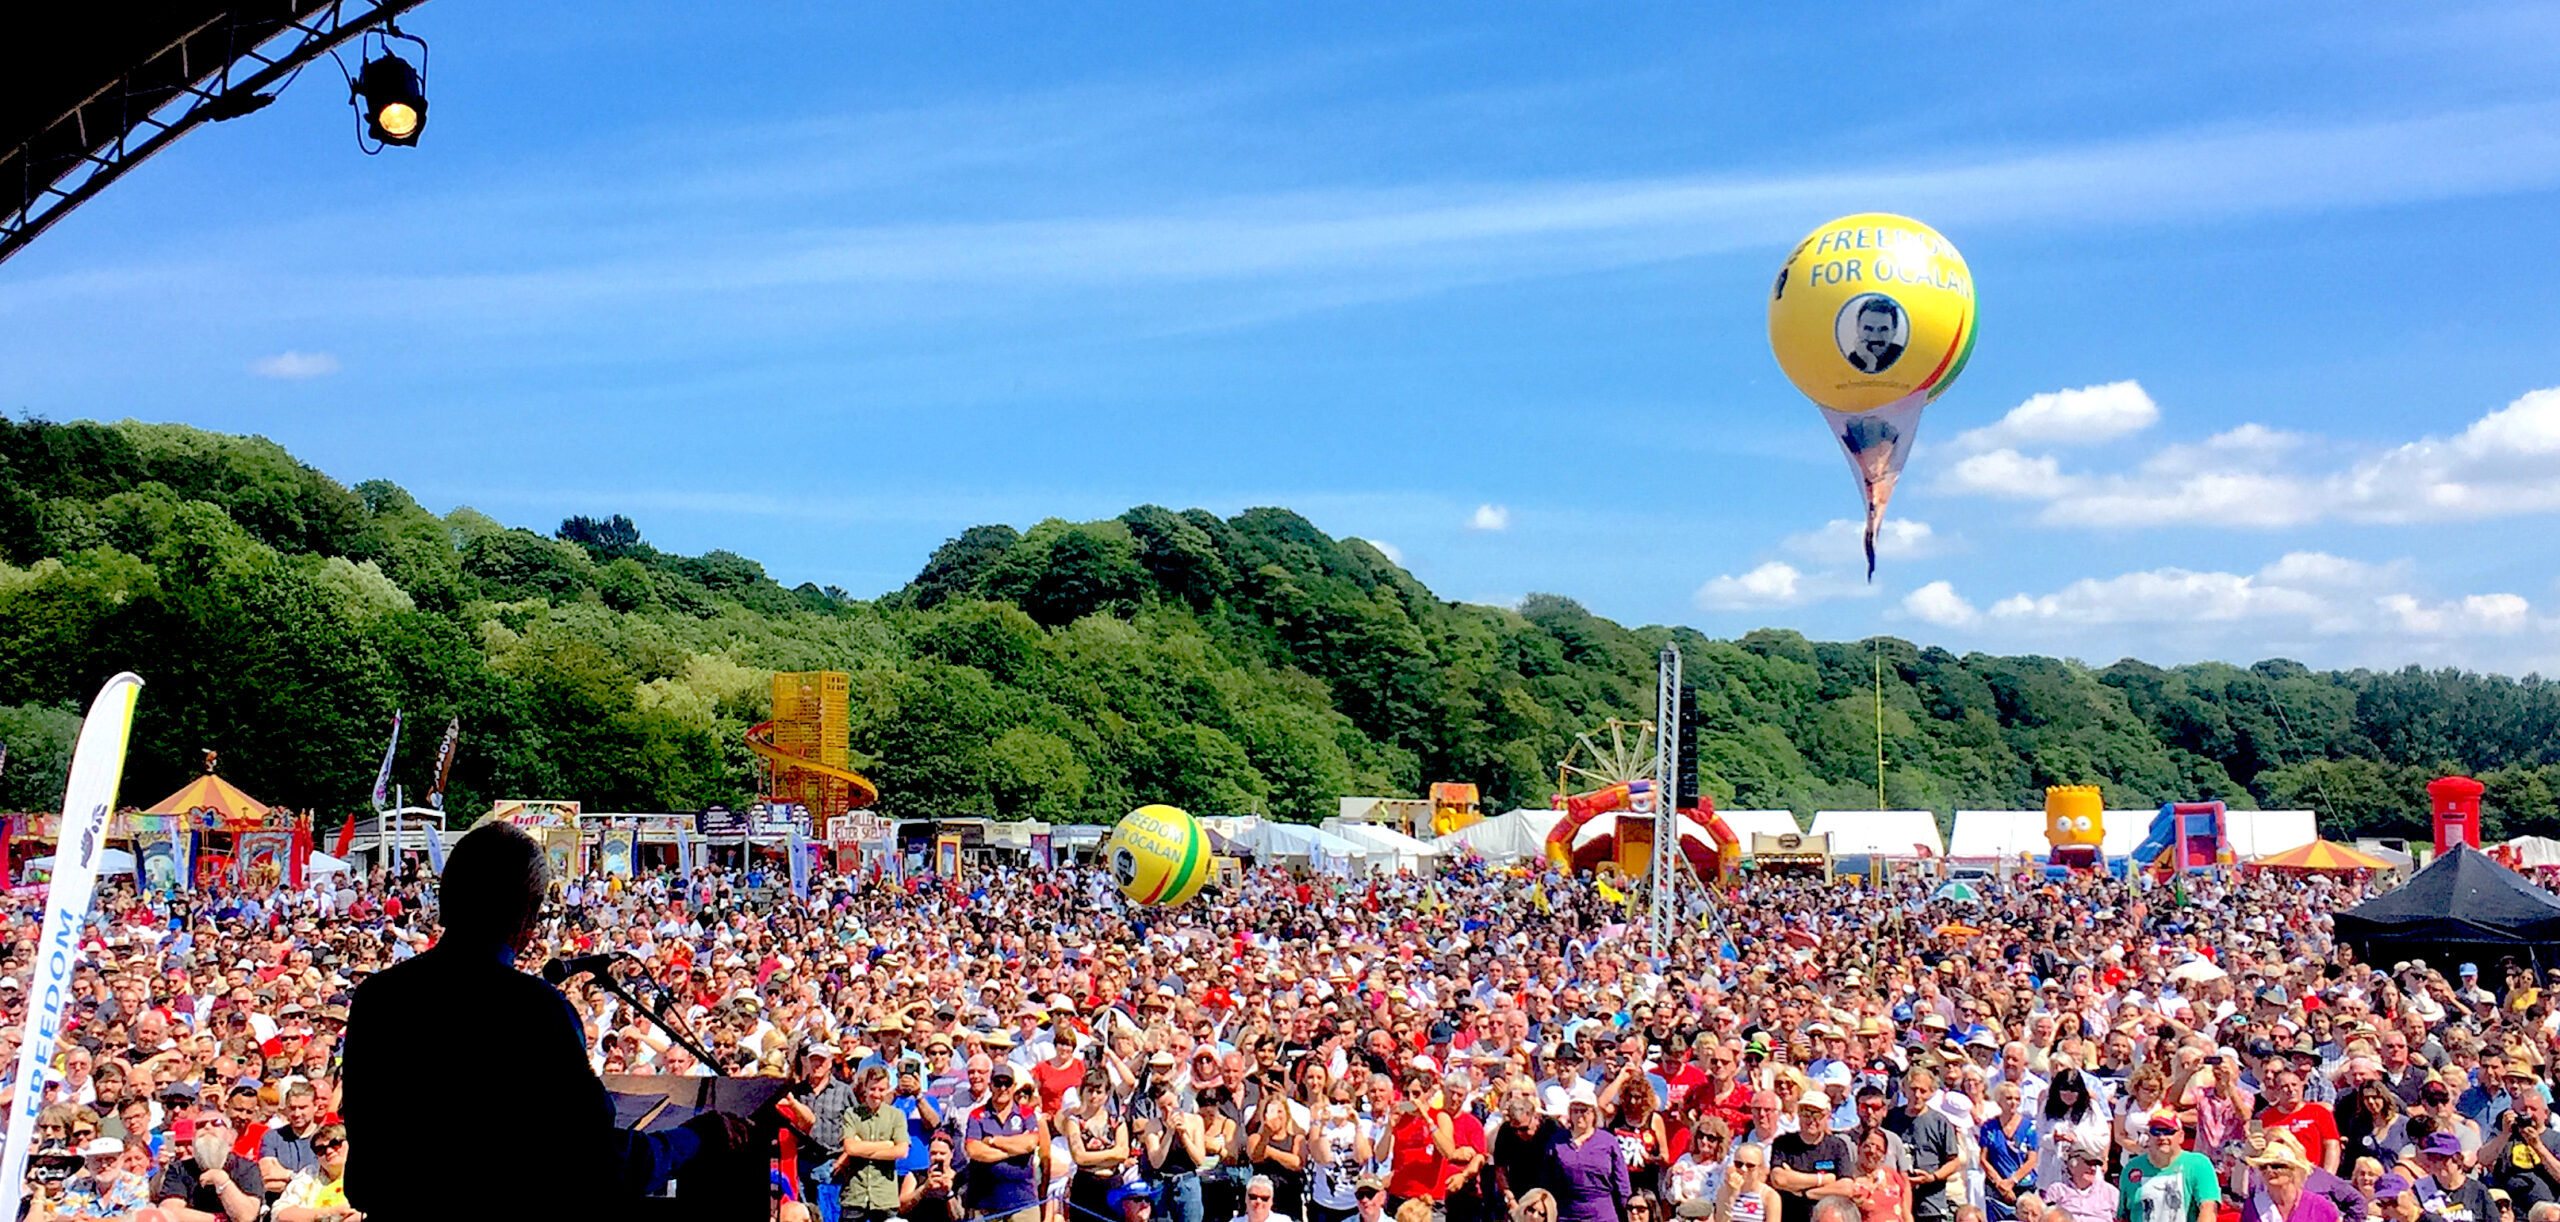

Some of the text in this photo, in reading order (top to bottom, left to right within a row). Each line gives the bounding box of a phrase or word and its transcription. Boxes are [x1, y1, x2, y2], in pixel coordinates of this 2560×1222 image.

[1811, 259, 1862, 287] FOR
[1129, 832, 1180, 863] OCALAN
[26, 908, 73, 1117] FREEDOM
